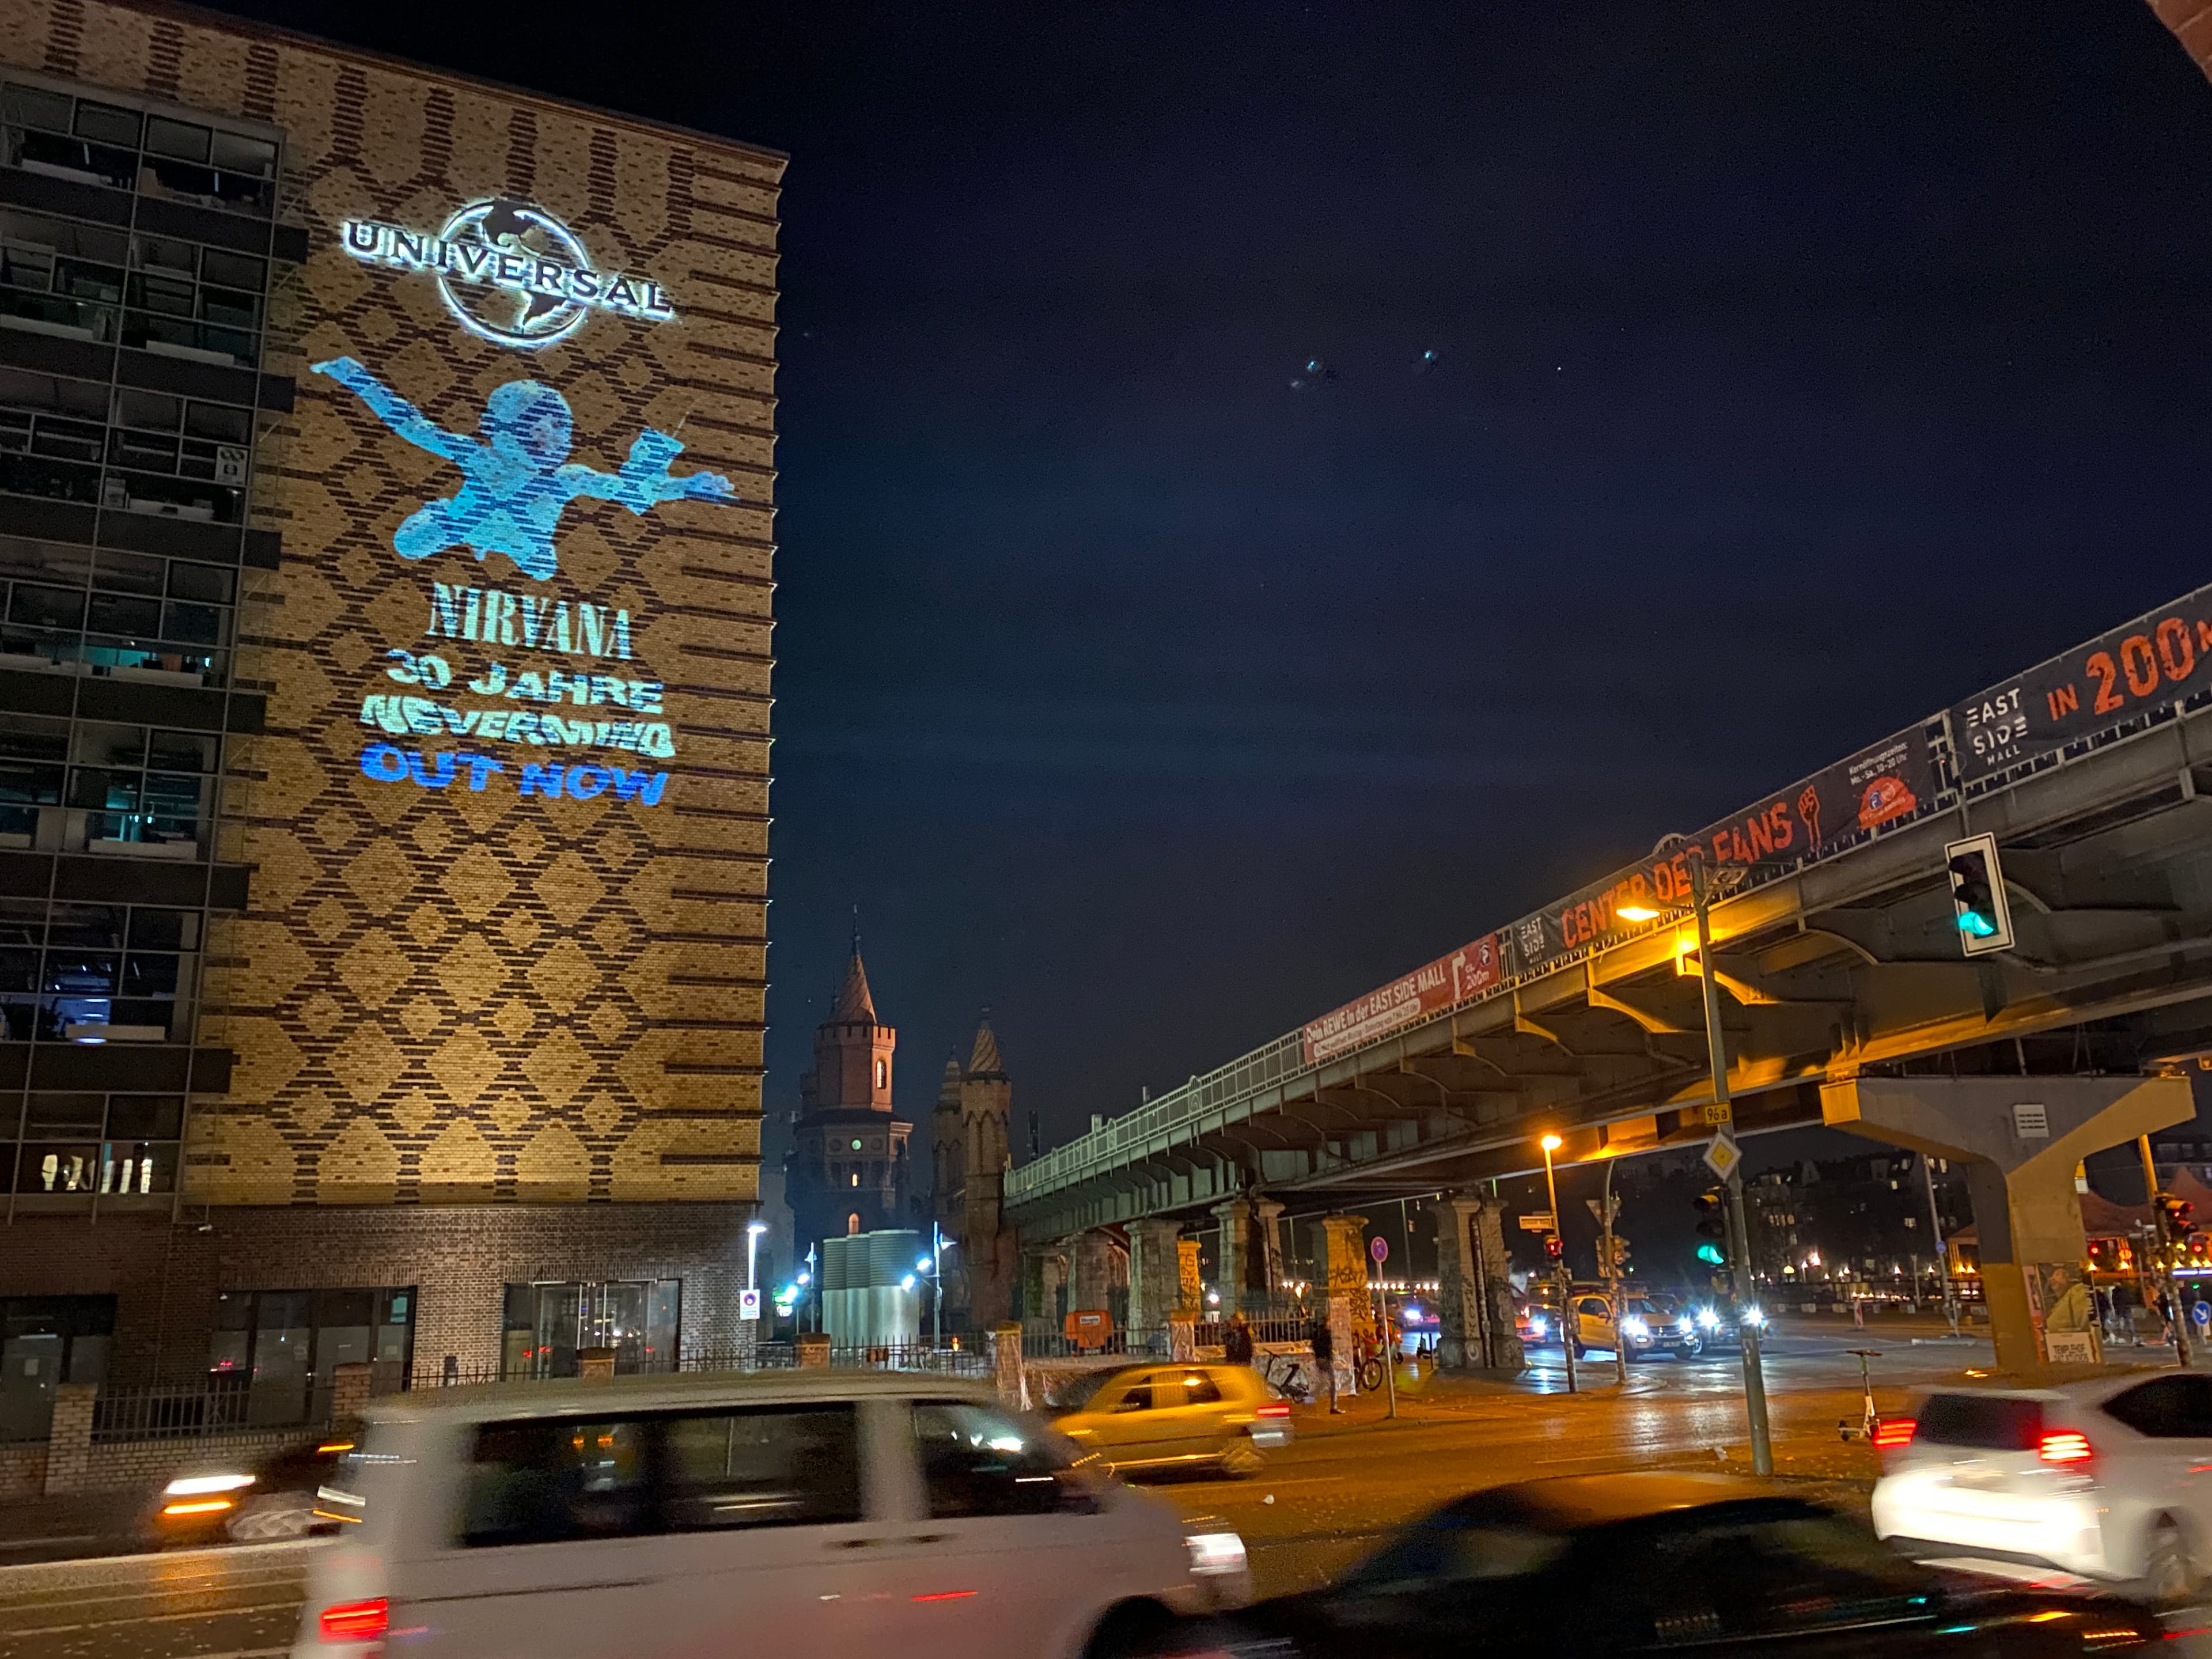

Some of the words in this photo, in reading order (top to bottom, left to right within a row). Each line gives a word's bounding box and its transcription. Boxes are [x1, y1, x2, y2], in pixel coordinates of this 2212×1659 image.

[346, 221, 672, 316] UNIVERSAL
[426, 582, 633, 660] NIRVANA
[387, 648, 451, 690] 30
[468, 661, 664, 714] JAHRE
[2047, 684, 2079, 721] IN
[2086, 618, 2194, 715] 200
[359, 694, 676, 758] NEVERMIND
[1966, 688, 2020, 728] EAST
[1974, 716, 2028, 755] SIDE
[359, 742, 505, 791] OUT
[520, 762, 668, 806] NOW
[1521, 916, 1541, 939] EAST
[1524, 934, 1545, 957] SIDE
[1323, 1012, 1347, 1037] REWE
[1346, 1009, 1355, 1027] in
[1355, 1004, 1369, 1022] der
[1369, 989, 1392, 1015] EAST
[1393, 977, 1416, 1004] SIDE
[1418, 964, 1446, 993] MALL
